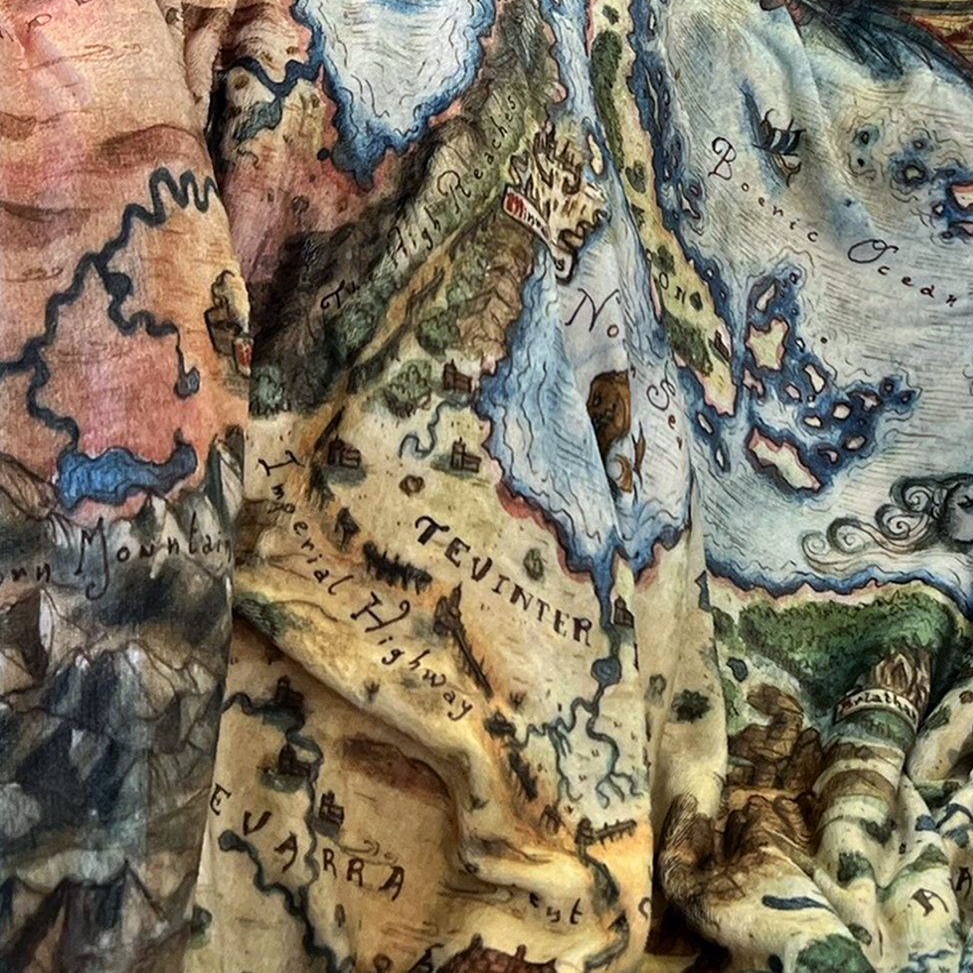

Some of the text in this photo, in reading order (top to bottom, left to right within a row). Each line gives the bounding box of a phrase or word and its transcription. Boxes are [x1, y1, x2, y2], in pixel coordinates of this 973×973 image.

[436, 95, 516, 214] Reaches
[848, 238, 958, 308] Ocean
[258, 449, 354, 595] Imperial
[414, 515, 593, 647] TEVINTER
[349, 591, 474, 722] Highway
